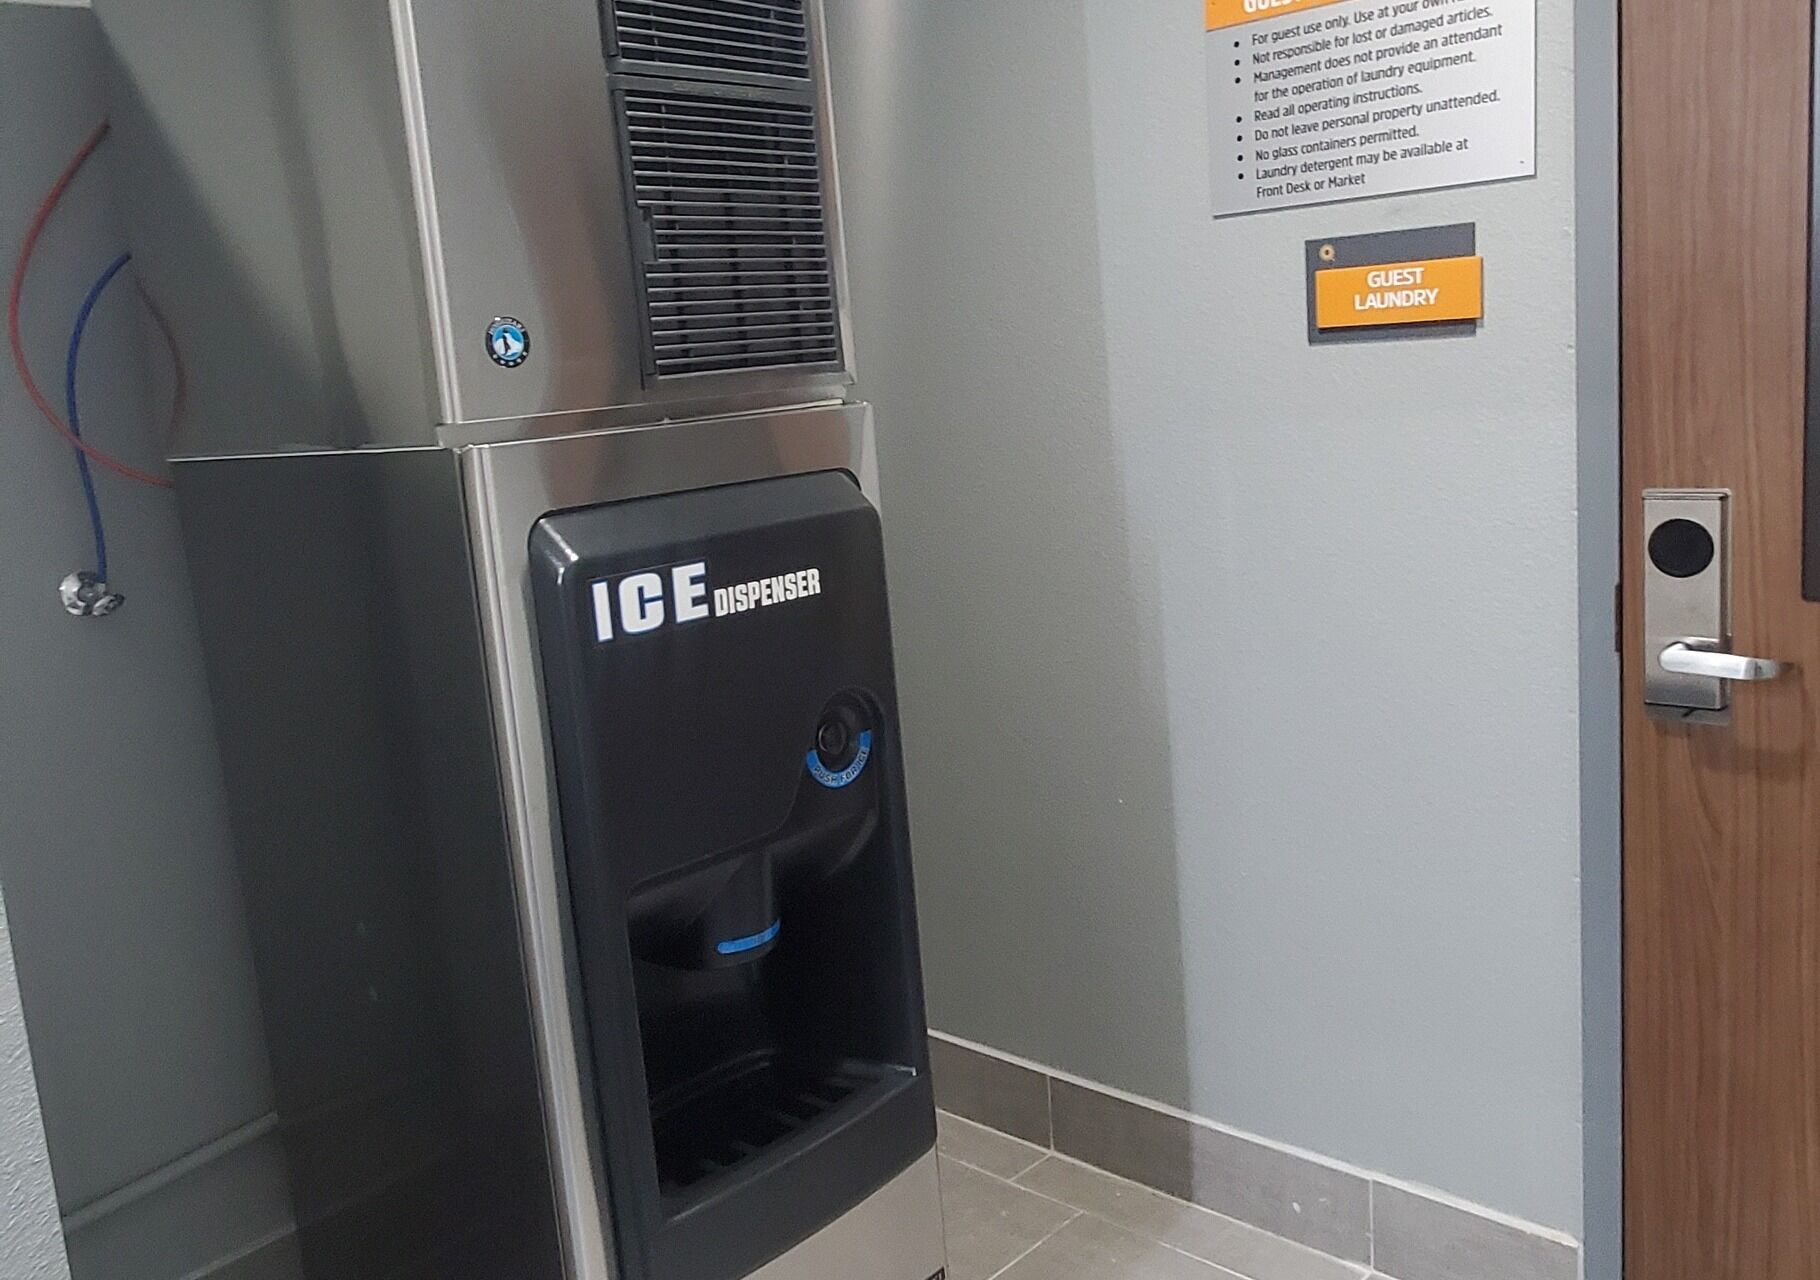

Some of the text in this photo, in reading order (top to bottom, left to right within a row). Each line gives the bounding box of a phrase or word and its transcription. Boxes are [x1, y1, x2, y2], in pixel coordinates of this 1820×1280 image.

[1252, 33, 1268, 46] For
[1271, 25, 1301, 43] guest
[1303, 22, 1322, 35] use
[1324, 15, 1351, 29] only.
[1353, 10, 1375, 24] Use
[1377, 6, 1390, 19] at
[1392, 0, 1419, 18] your
[1252, 6, 1493, 65] Not responsible for lost or damaged articles.
[1253, 23, 1504, 83] Management does not provide an attendant
[1254, 50, 1477, 103] for the operation of laundry equipment.
[1254, 83, 1423, 122] Read all operating instructions.
[1254, 89, 1501, 141] Do not leave personal property unattended.
[1255, 125, 1420, 161] No glass containers permitted.
[1256, 138, 1469, 180] Laundry detergent may be available at
[1256, 173, 1366, 199] Front Desk or Market
[1354, 287, 1439, 310] LAUNDRY
[1367, 267, 1425, 288] GUEST
[592, 561, 821, 642] ICE DISPENSER
